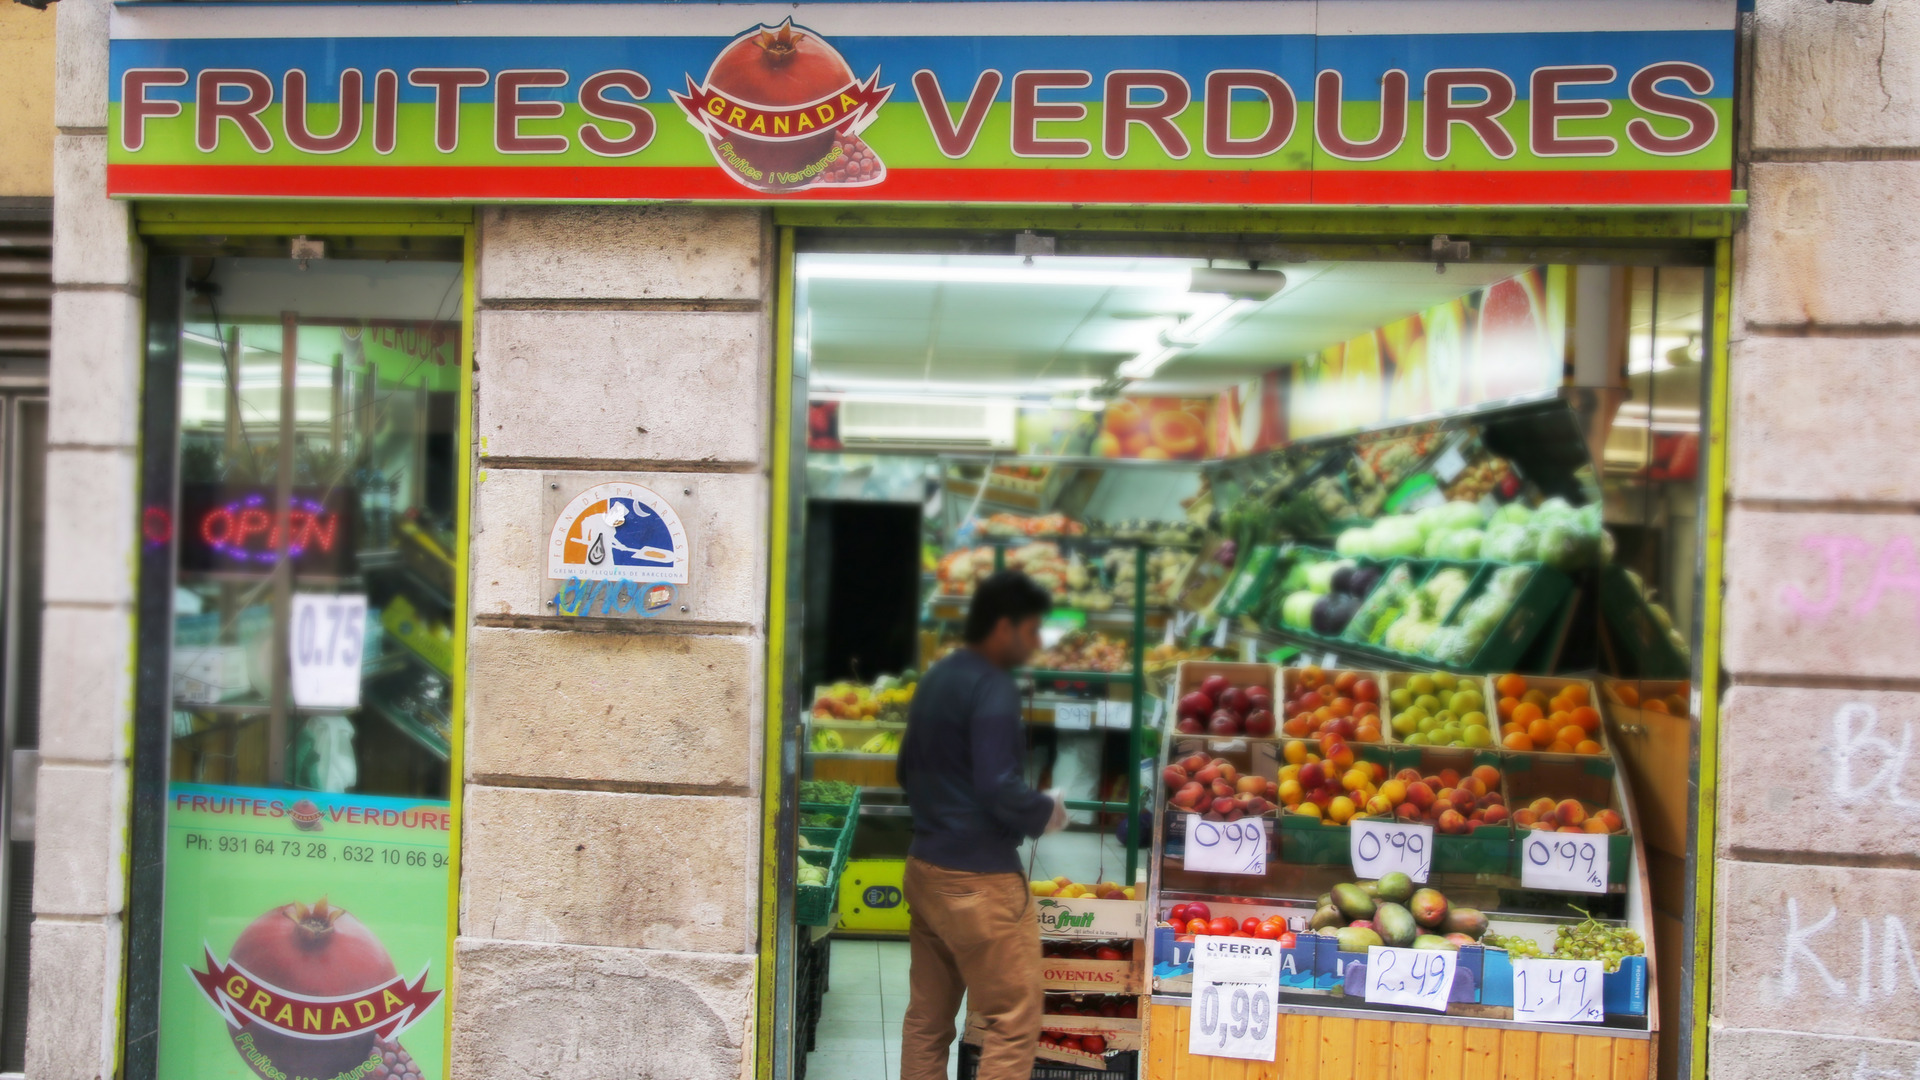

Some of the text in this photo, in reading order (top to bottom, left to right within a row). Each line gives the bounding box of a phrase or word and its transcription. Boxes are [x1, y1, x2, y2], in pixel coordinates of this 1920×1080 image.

[120, 67, 657, 157] FRUITES
[707, 93, 859, 134] GRANADA
[911, 60, 1719, 161] VERDURES
[717, 141, 843, 184] Fruites i Verdures
[200, 508, 338, 552] OPEN
[298, 604, 363, 667] 0.75
[176, 794, 285, 817] FRUITES
[186, 834, 212, 850] Ph:
[219, 836, 247, 853] 931
[254, 839, 275, 855] 64
[281, 841, 301, 857] 73
[306, 842, 327, 859] 28
[343, 846, 374, 862] 632
[381, 849, 400, 865] 10
[406, 851, 427, 867] 66
[1195, 822, 1260, 856] 0'99
[1358, 831, 1424, 866] 0'99
[1529, 841, 1596, 873] 0'99
[1207, 942, 1273, 956] OFERTA
[1376, 950, 1446, 997] 2,49
[1516, 967, 1587, 1013] 1,49
[226, 975, 404, 1031] GRANADA
[1200, 986, 1270, 1048] 0,99
